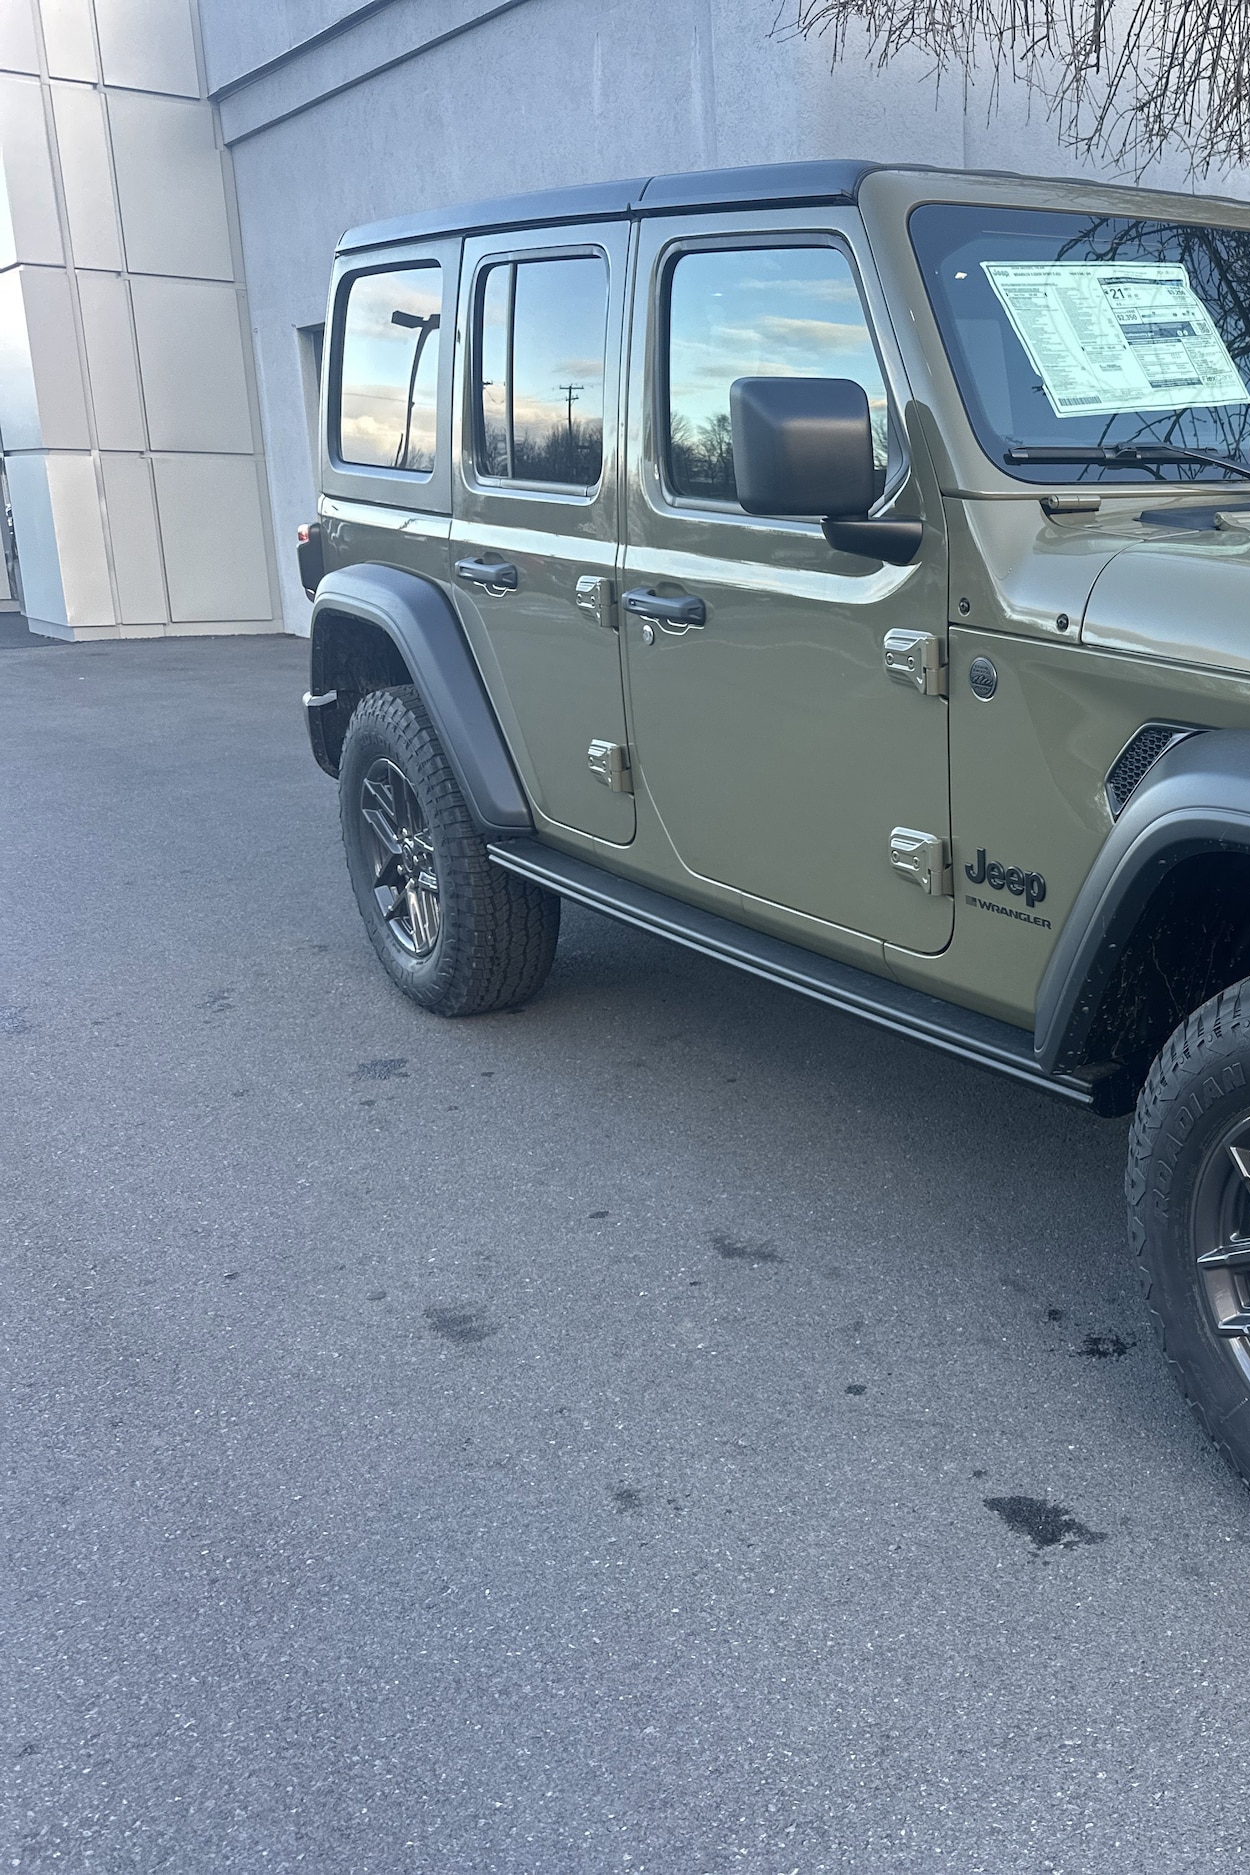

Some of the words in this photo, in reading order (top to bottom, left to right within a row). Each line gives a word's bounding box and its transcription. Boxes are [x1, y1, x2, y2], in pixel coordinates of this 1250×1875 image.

[1109, 288, 1125, 299] 21
[965, 846, 1047, 908] Jeep
[977, 898, 1052, 930] WRANGLER
[1153, 1061, 1247, 1224] ROADIAN
